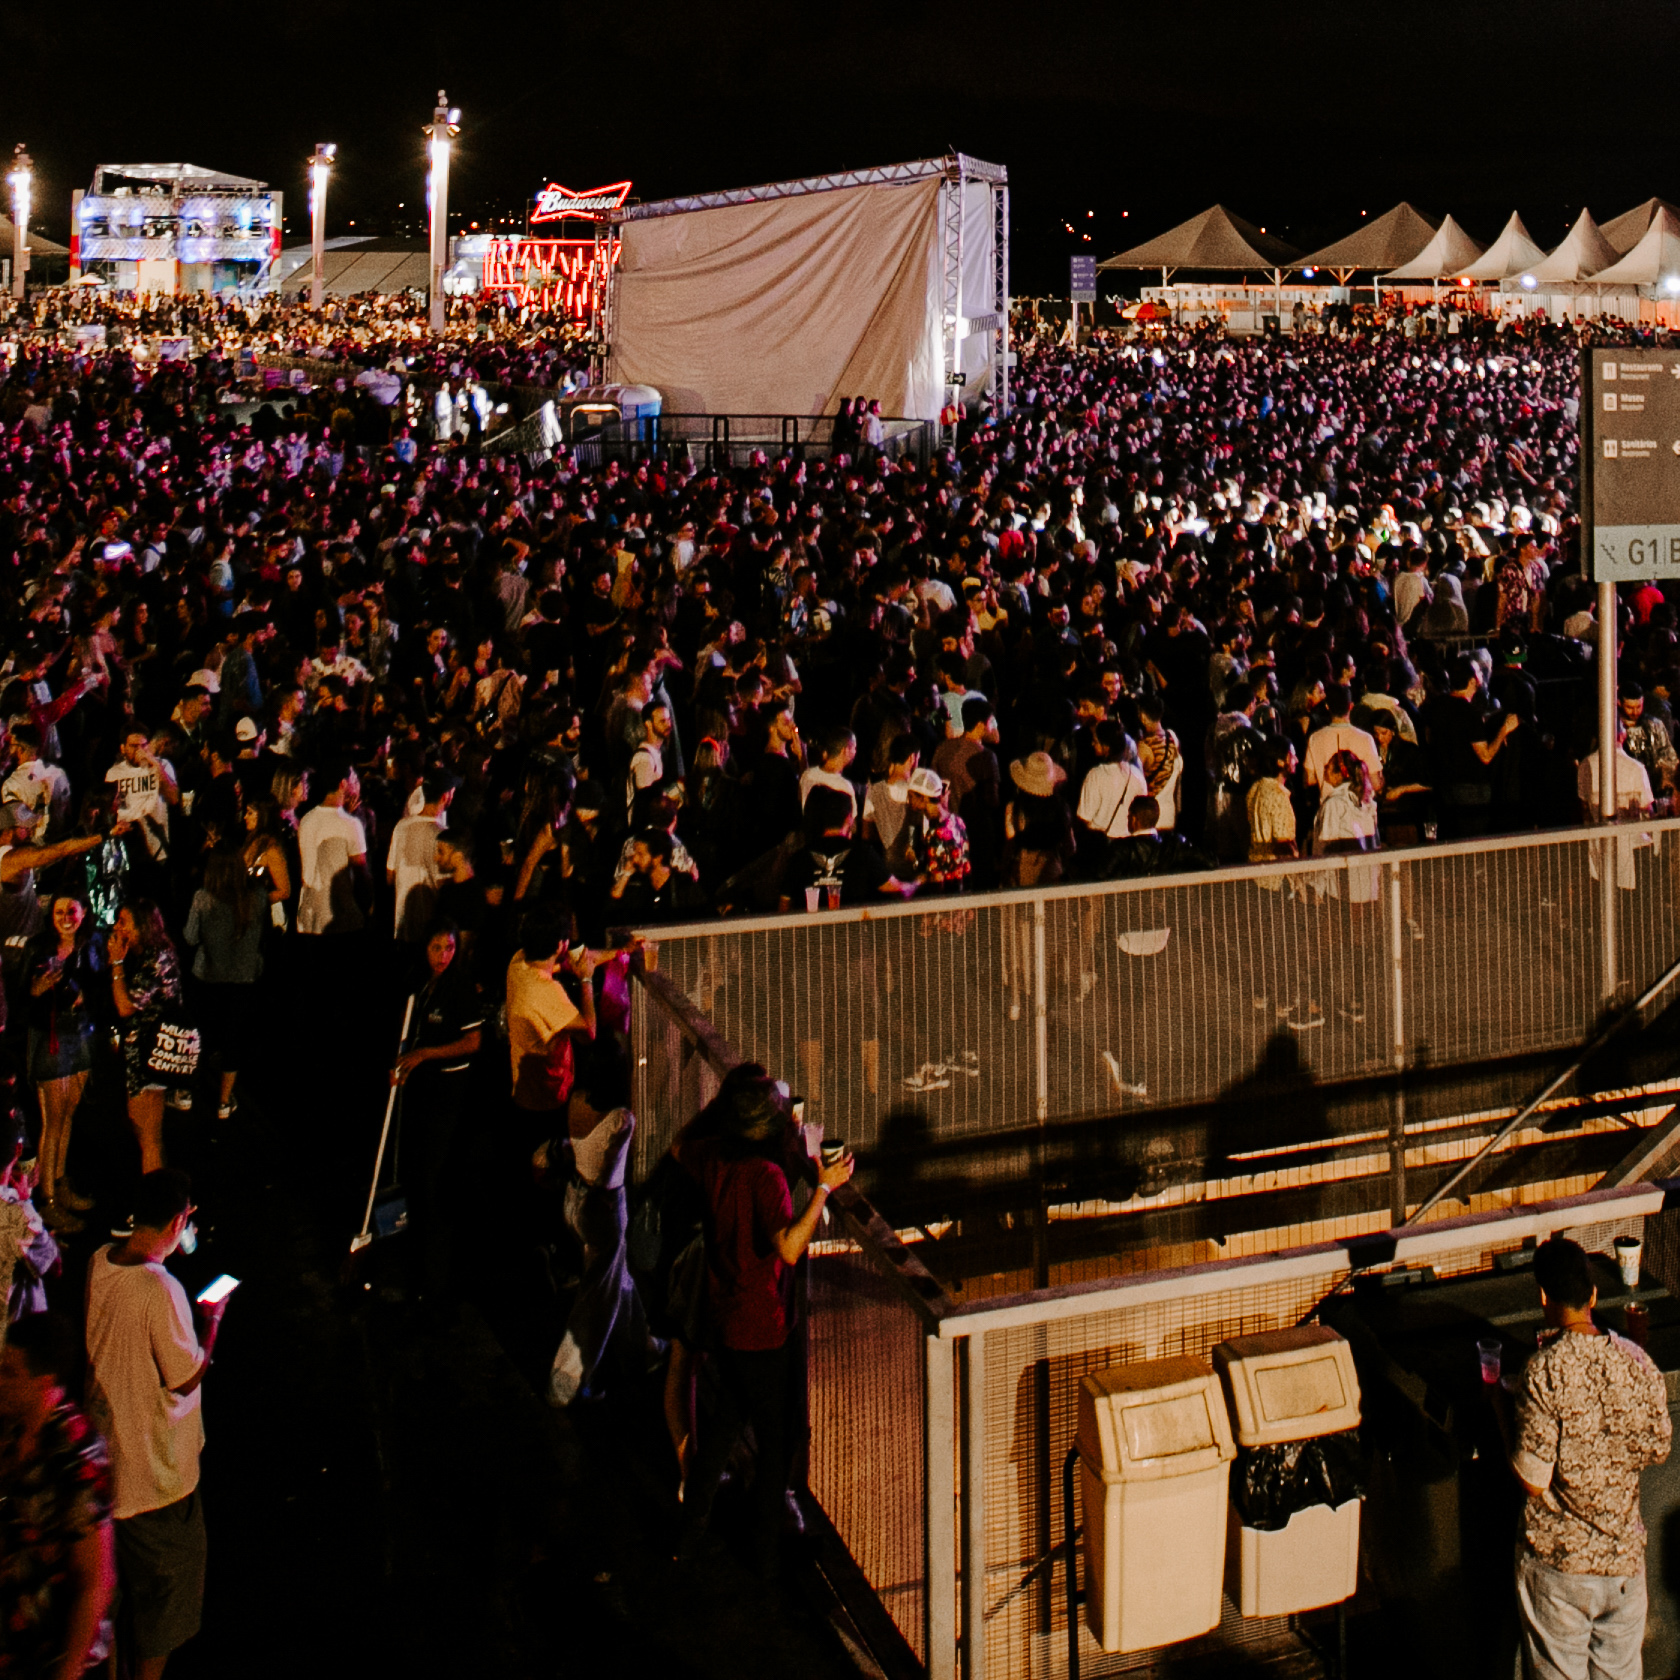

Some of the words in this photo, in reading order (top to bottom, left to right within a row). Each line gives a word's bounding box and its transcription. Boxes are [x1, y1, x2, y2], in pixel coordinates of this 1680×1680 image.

[537, 190, 619, 213] Budweiser
[157, 1032, 175, 1051] TO
[176, 1038, 201, 1055] THE
